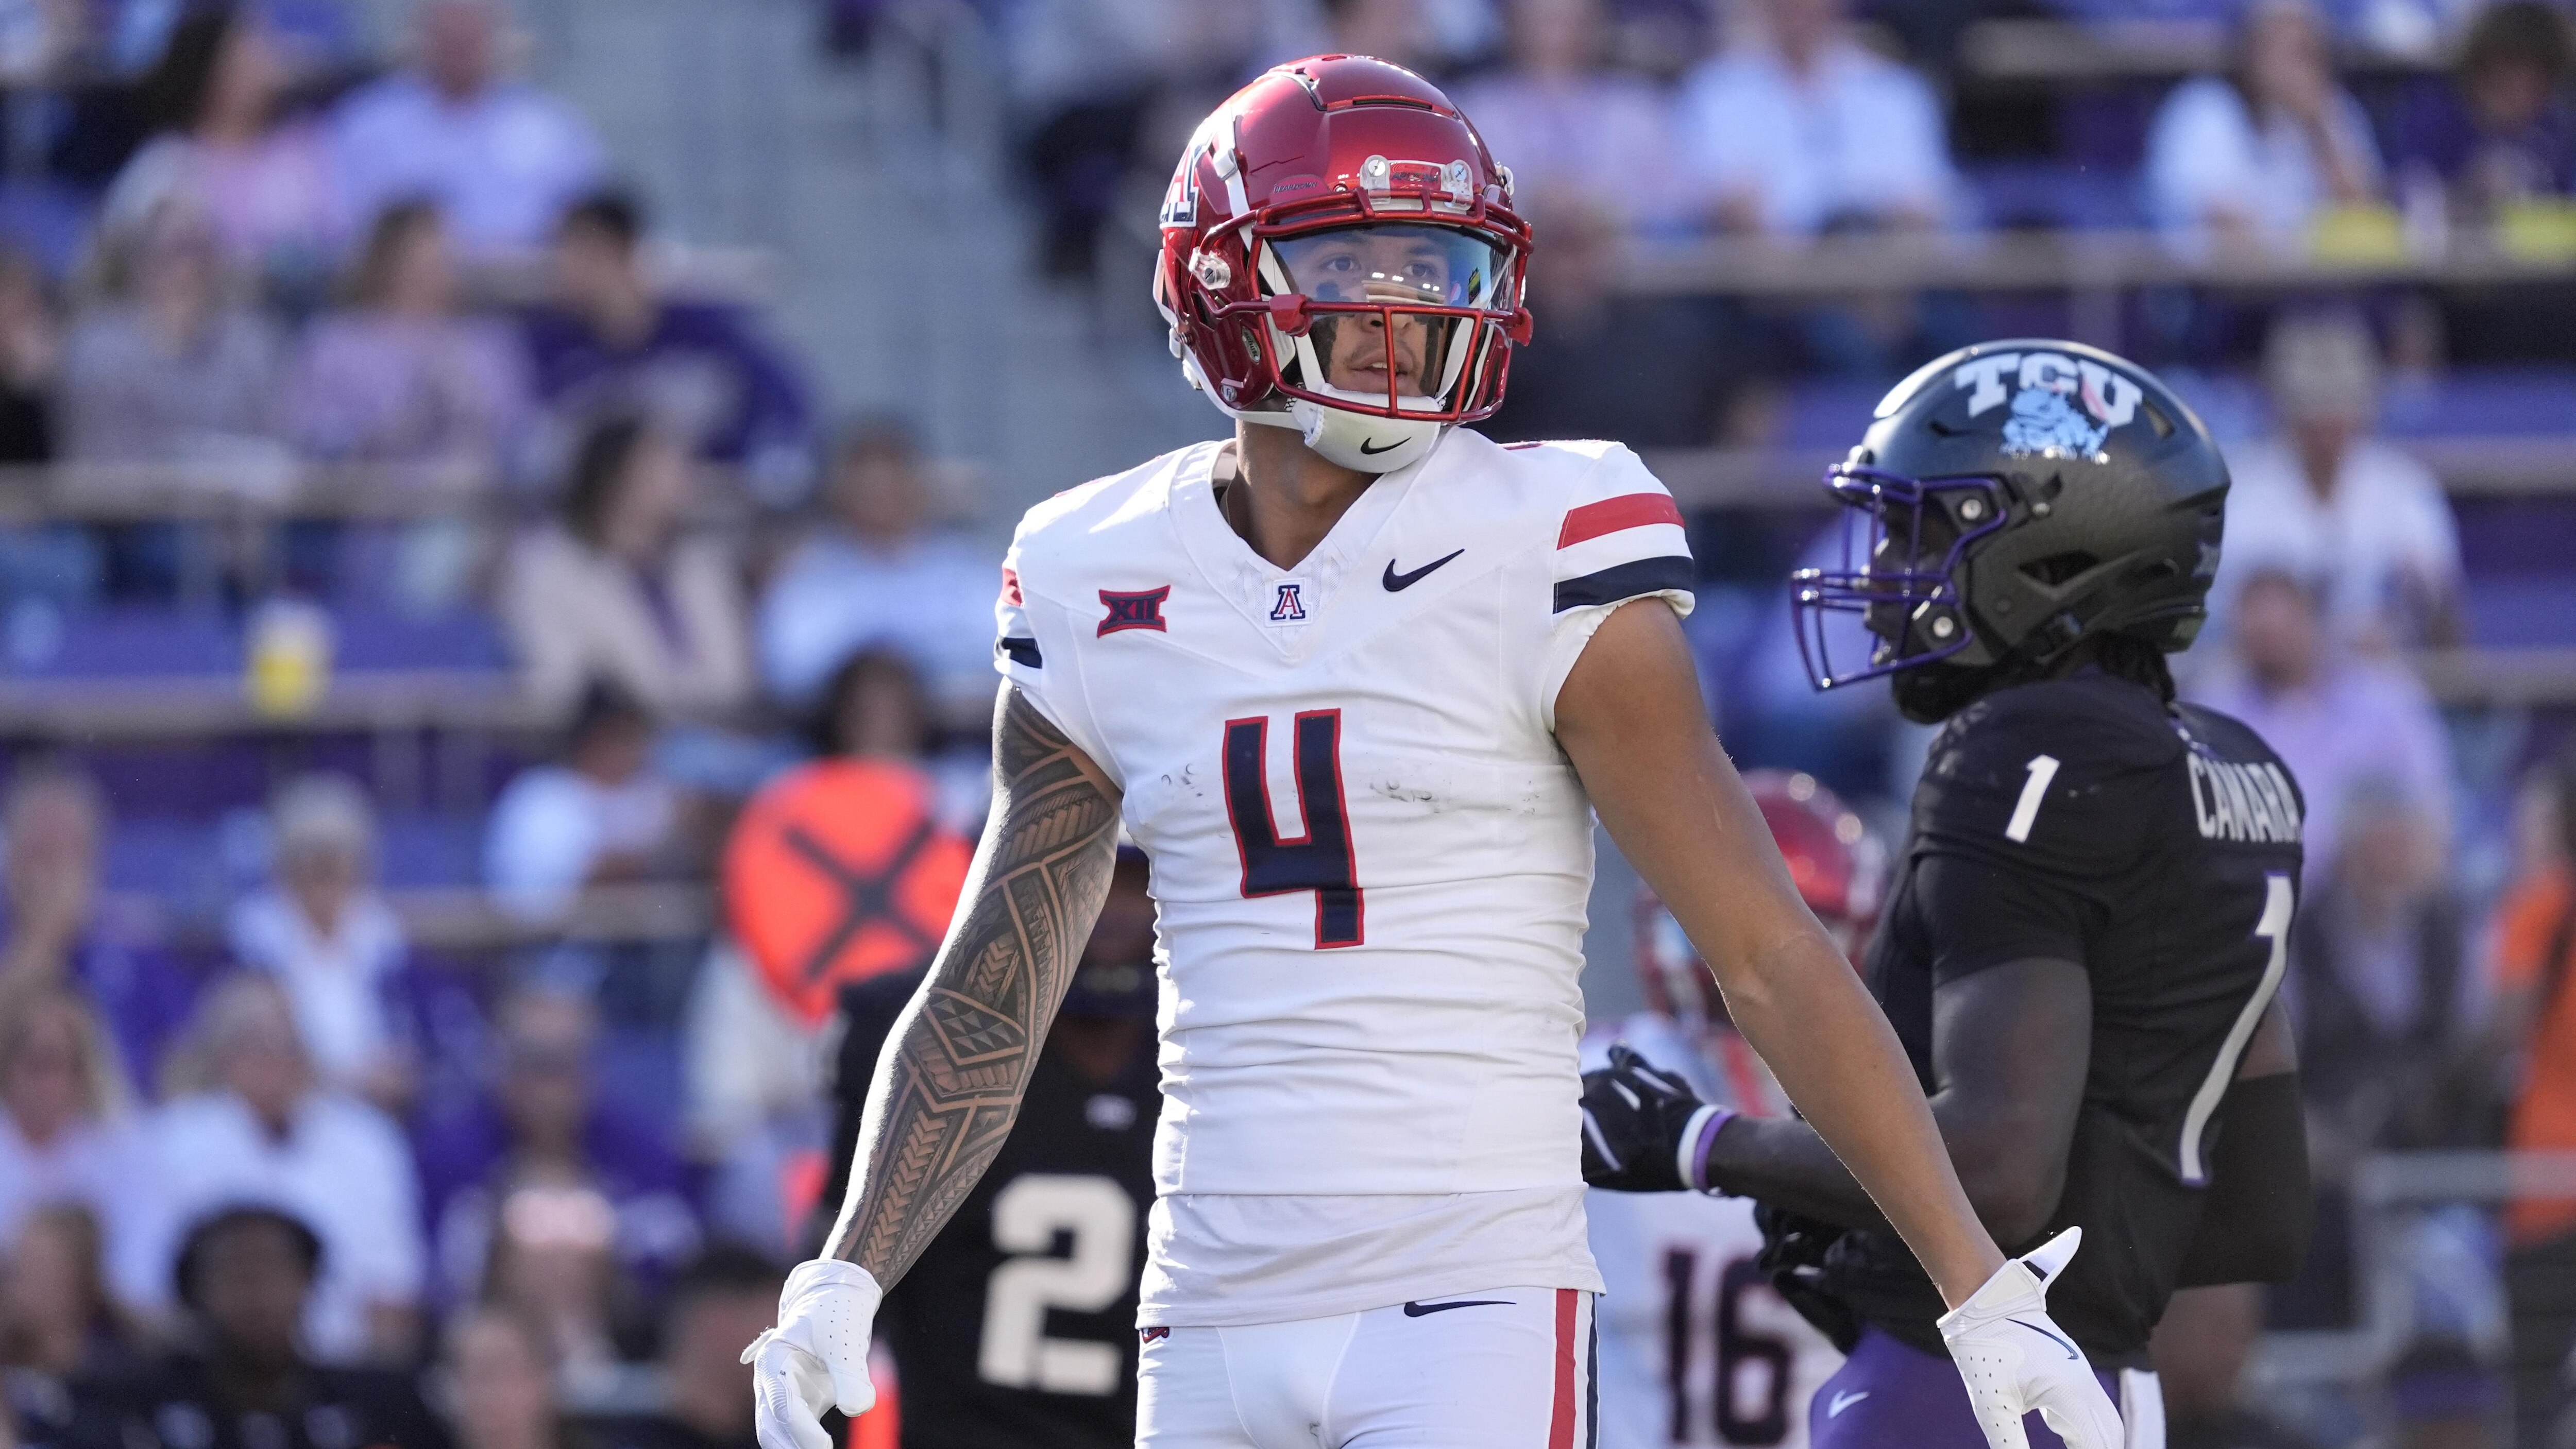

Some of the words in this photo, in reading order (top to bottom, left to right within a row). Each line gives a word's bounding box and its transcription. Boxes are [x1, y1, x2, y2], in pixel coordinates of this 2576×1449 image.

[1954, 352, 2143, 428] TCU
[1101, 590, 1166, 630] XII
[1270, 585, 1306, 620] A
[1222, 708, 1365, 950] 4
[2006, 754, 2060, 843] 1
[2179, 874, 2294, 1183] 1
[978, 1173, 1136, 1395] 2
[1666, 1251, 1794, 1446] 16
